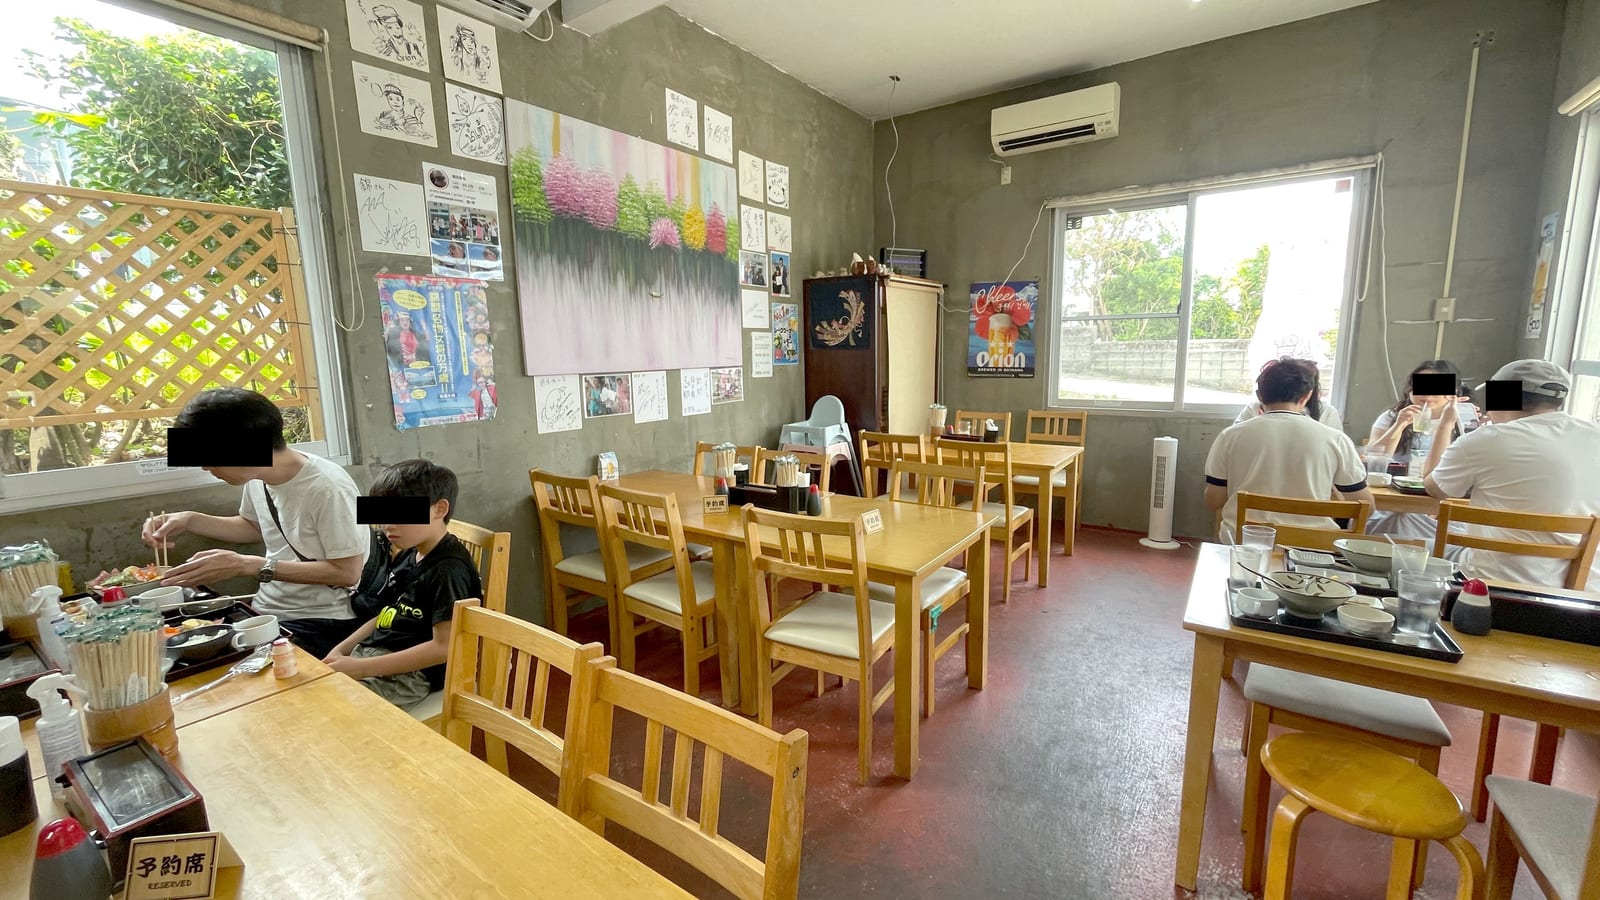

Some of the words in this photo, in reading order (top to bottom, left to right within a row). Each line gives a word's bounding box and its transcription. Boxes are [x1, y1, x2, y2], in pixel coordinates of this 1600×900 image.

[136, 853, 206, 879] 予約席
[148, 880, 192, 889] RESERVED
